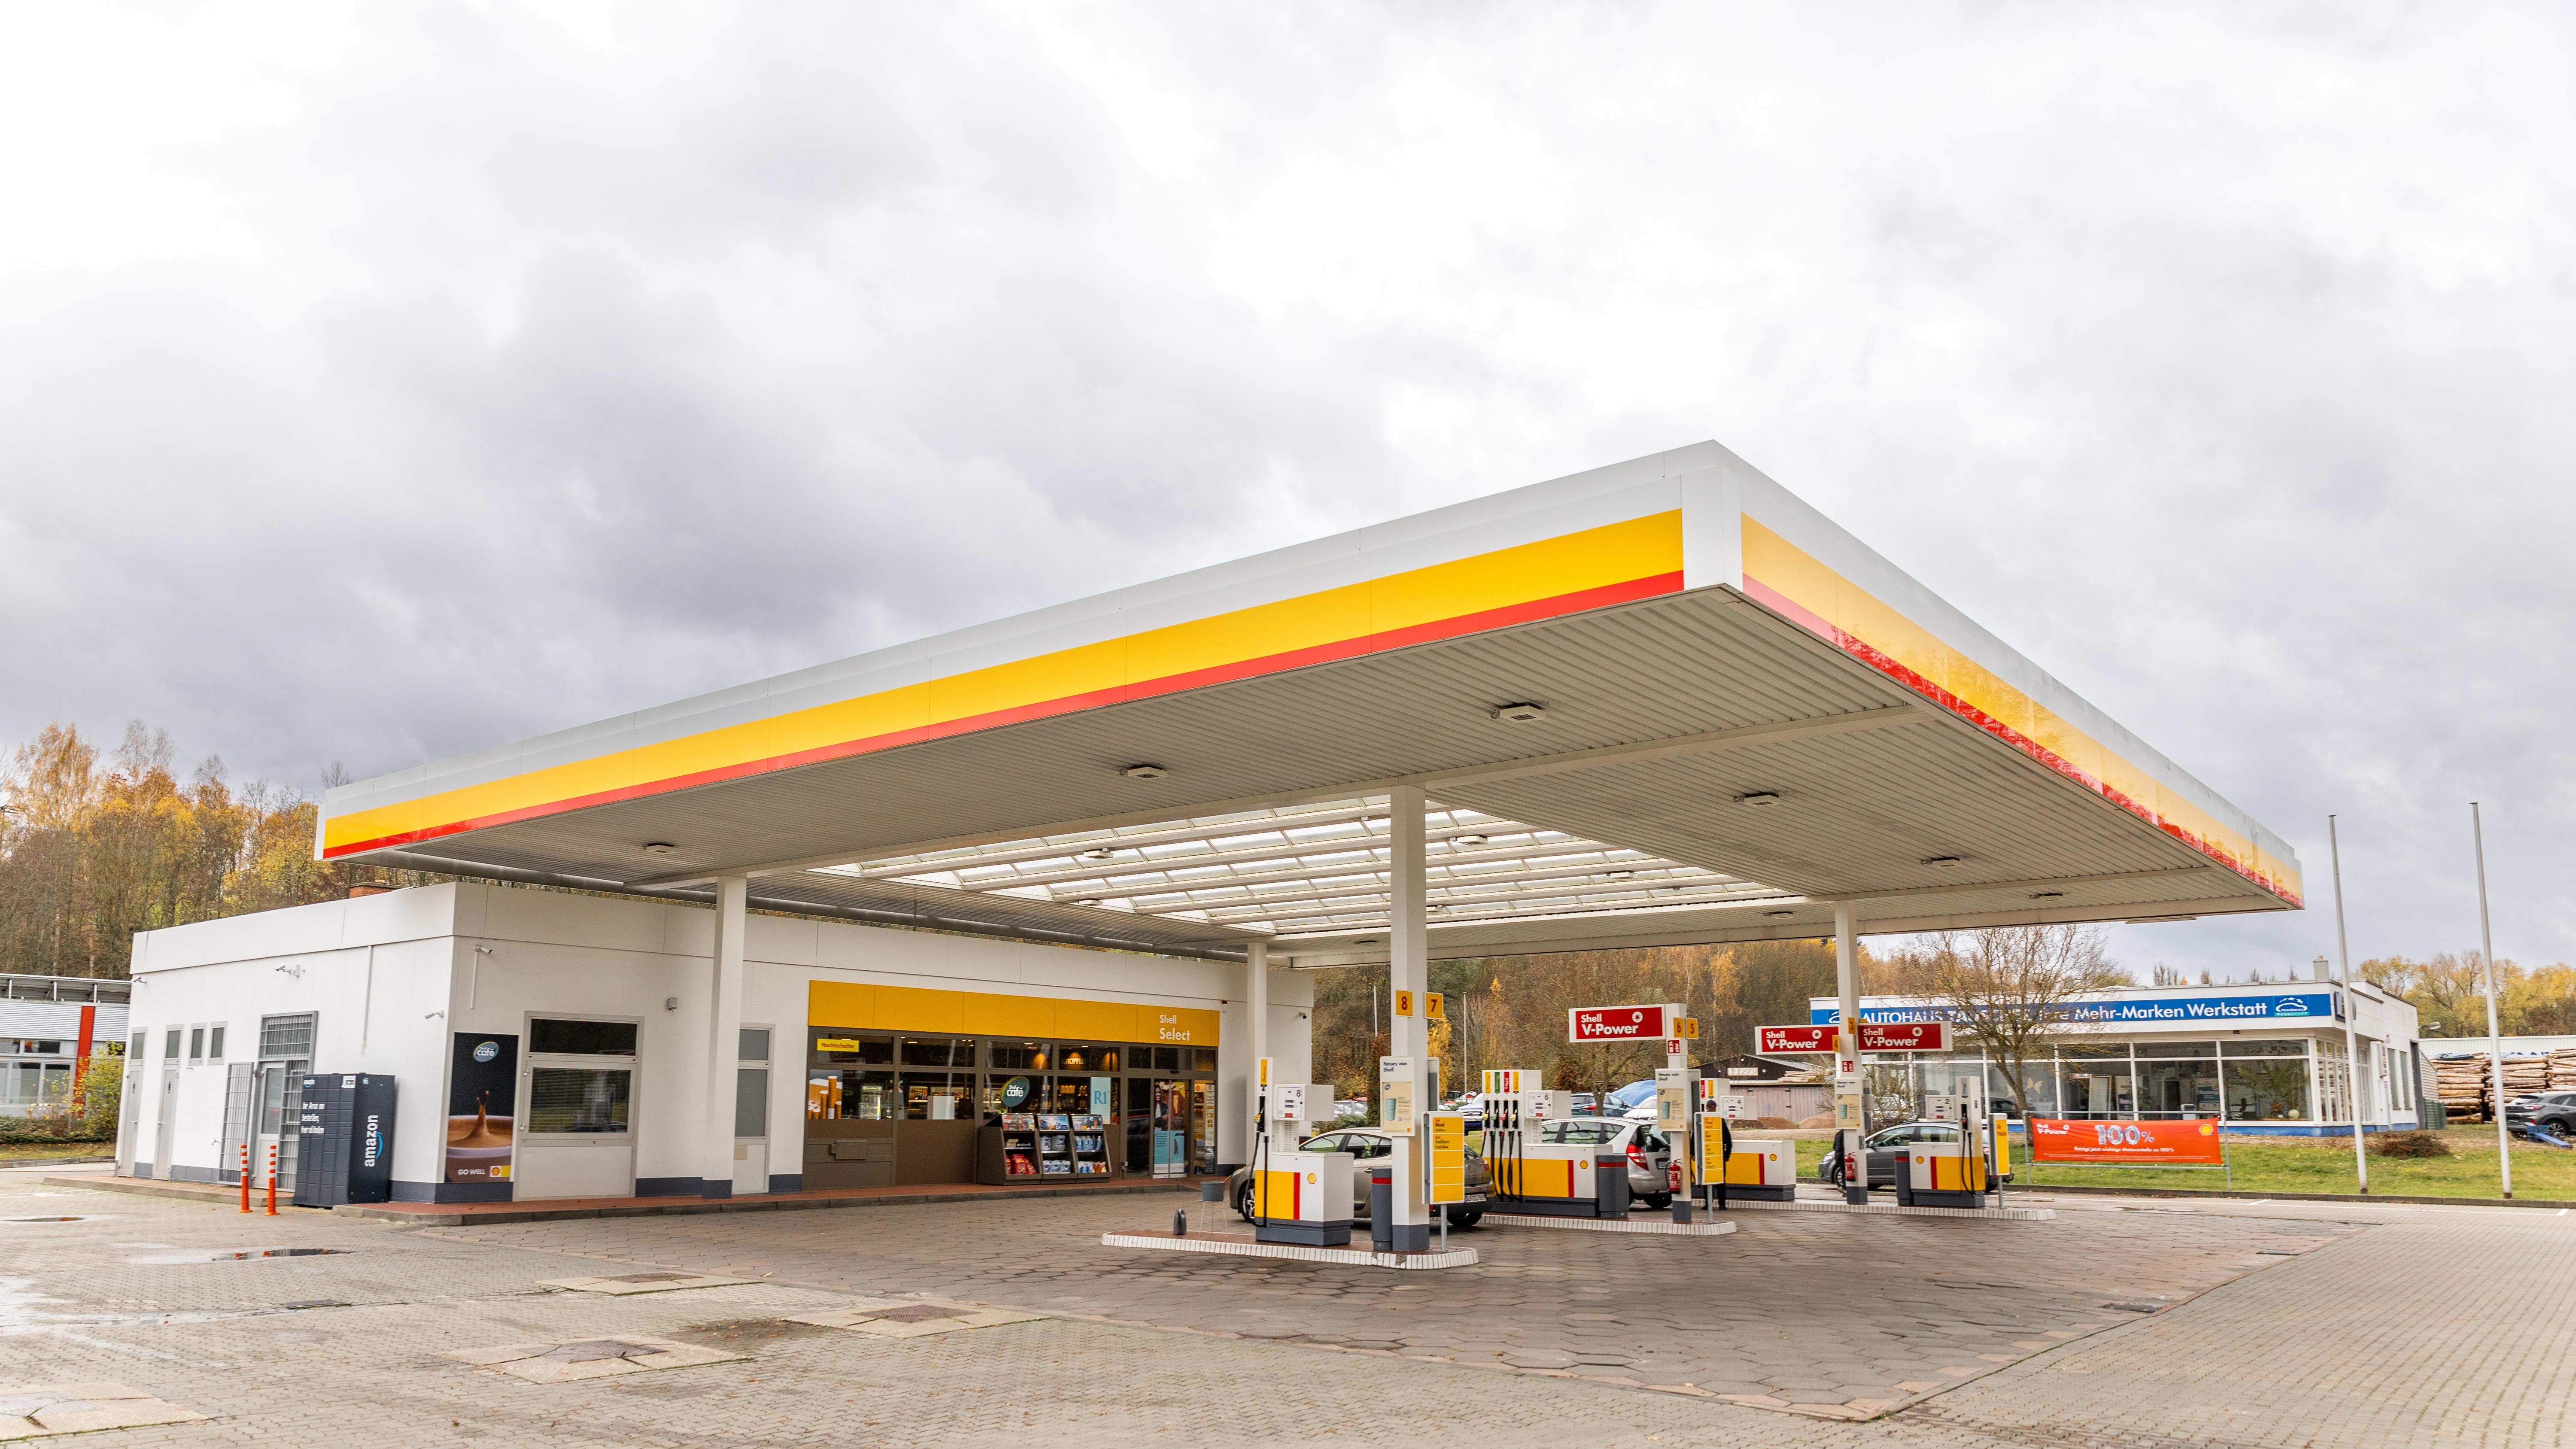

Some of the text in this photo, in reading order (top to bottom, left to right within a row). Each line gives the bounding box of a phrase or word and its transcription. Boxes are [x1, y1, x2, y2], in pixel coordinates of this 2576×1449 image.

[1401, 996, 1407, 1010] 8
[1431, 999, 1437, 1012] 7
[2075, 1004, 2184, 1019] Mehr-Marken
[2187, 1002, 2267, 1017] Werkstatt
[1160, 1015, 1177, 1024] Shell
[1581, 1013, 1602, 1023] Shell
[1581, 1023, 1639, 1035] V-Power
[1677, 1022, 1681, 1033] 6
[1691, 1023, 1694, 1034] 5
[1160, 1027, 1191, 1041] Select
[1766, 1039, 1818, 1049] V-Power
[1863, 1037, 1919, 1047] V-Power
[477, 1048, 495, 1056] café
[1006, 1086, 1024, 1097] café
[1094, 1091, 1106, 1104] R1
[2095, 1125, 2140, 1145] 100
[364, 1115, 379, 1167] amazon
